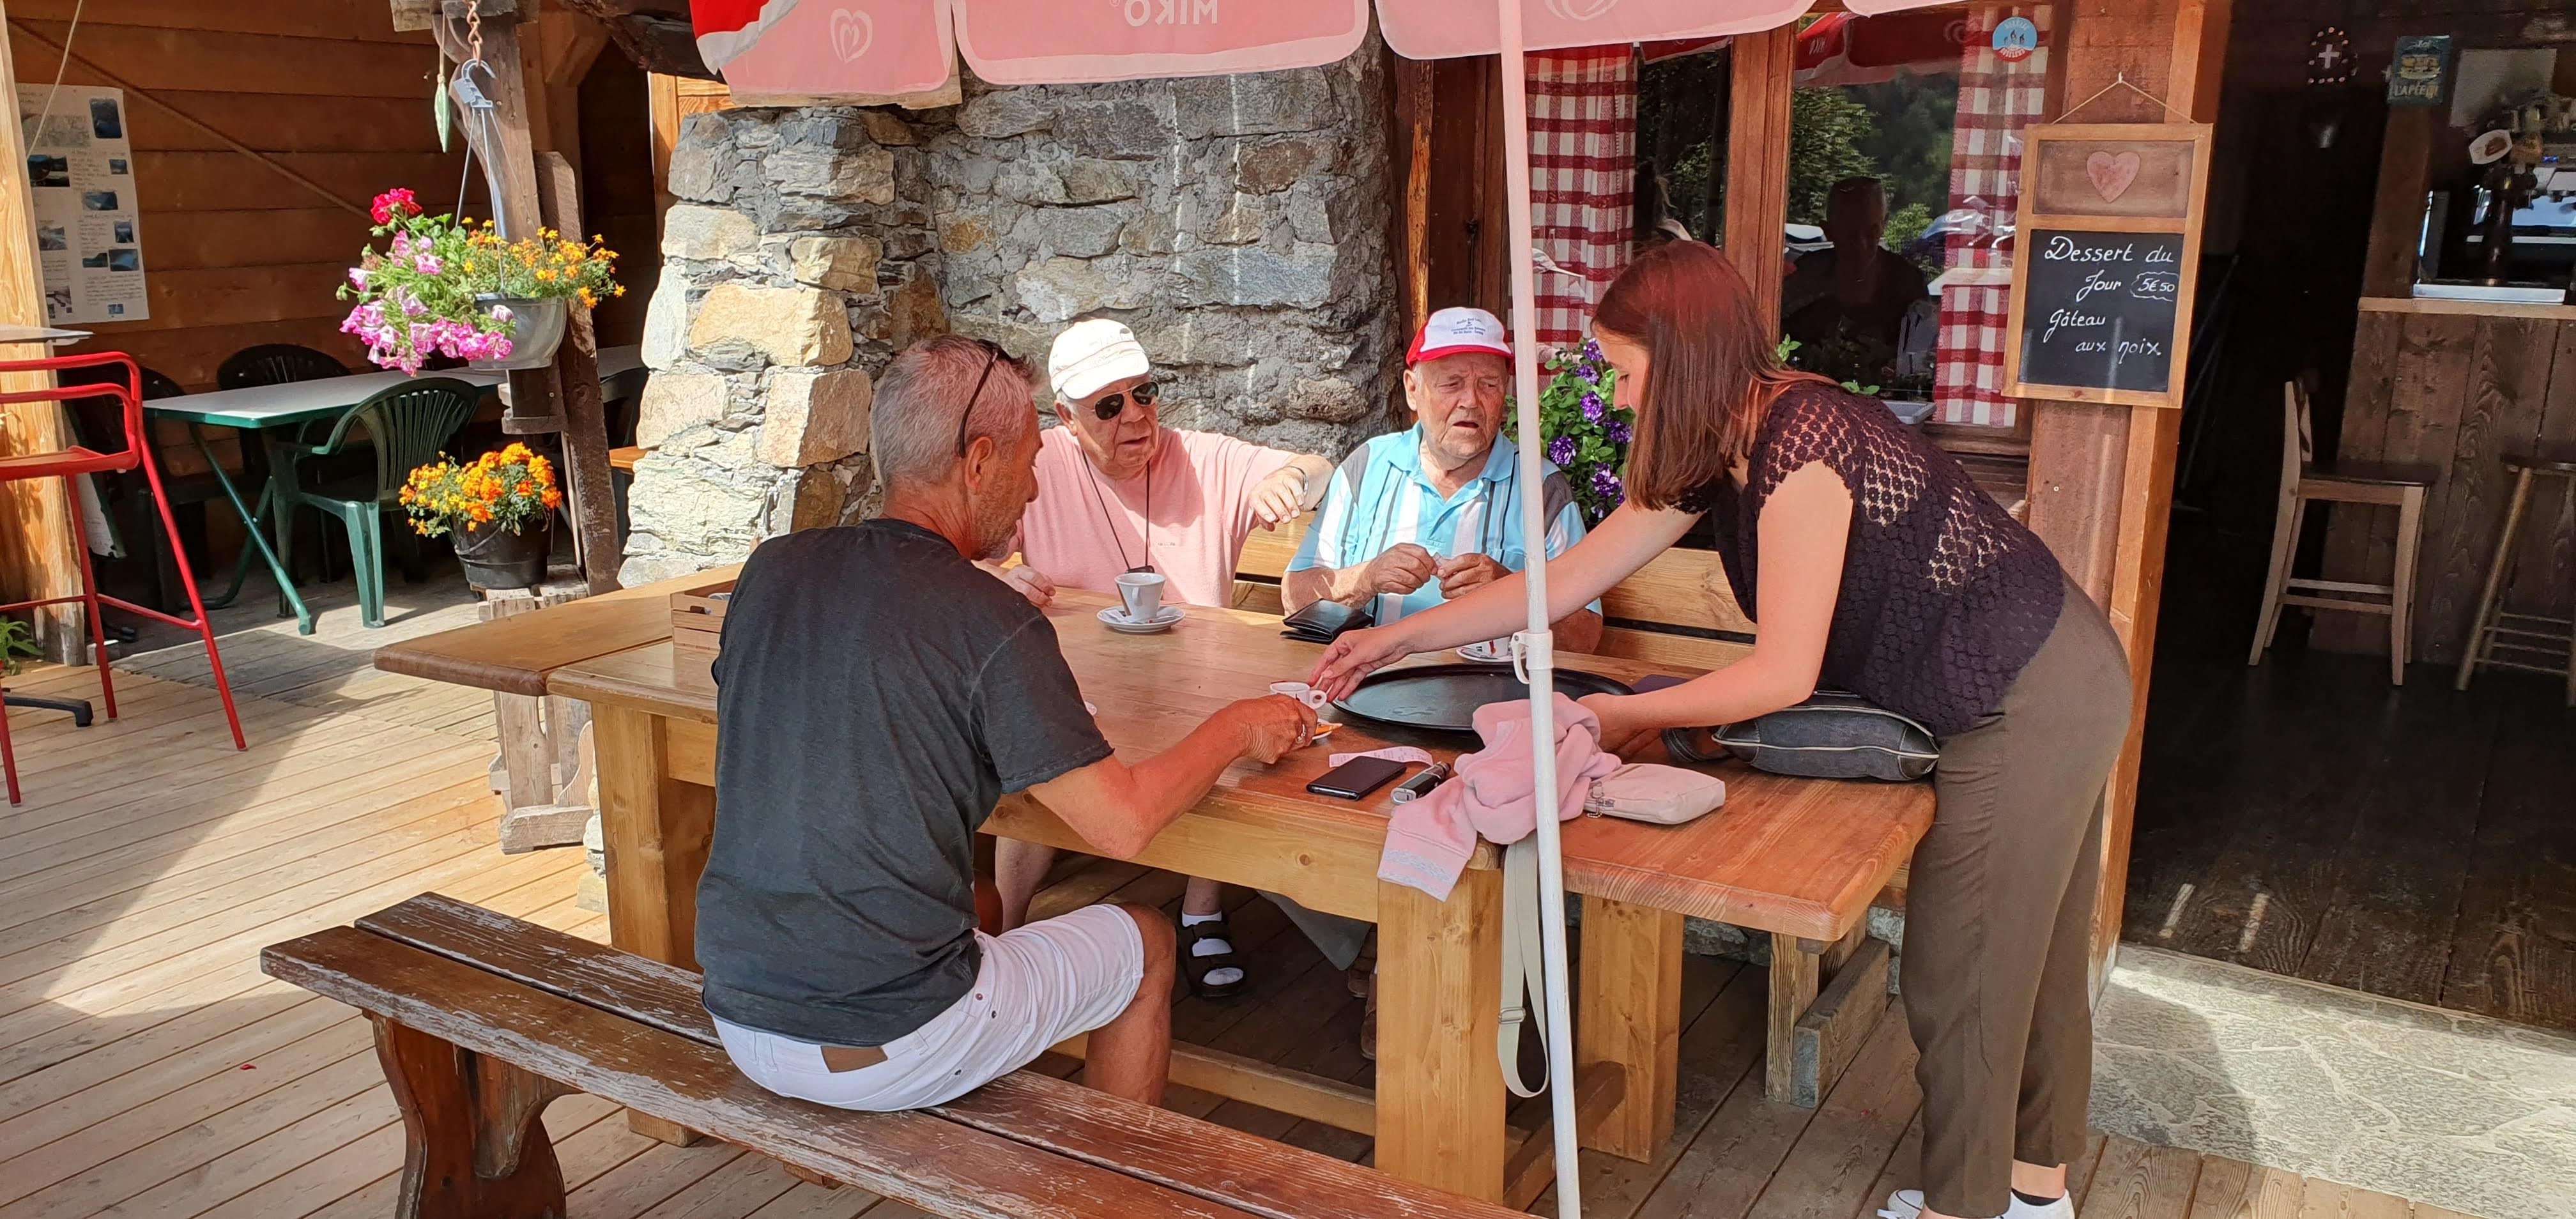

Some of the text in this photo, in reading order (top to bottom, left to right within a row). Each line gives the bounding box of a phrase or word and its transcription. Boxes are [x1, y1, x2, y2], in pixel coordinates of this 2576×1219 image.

[2044, 236, 2174, 263] Dessert du
[2076, 269, 2122, 302] Jour
[2075, 341, 2106, 352] aux
